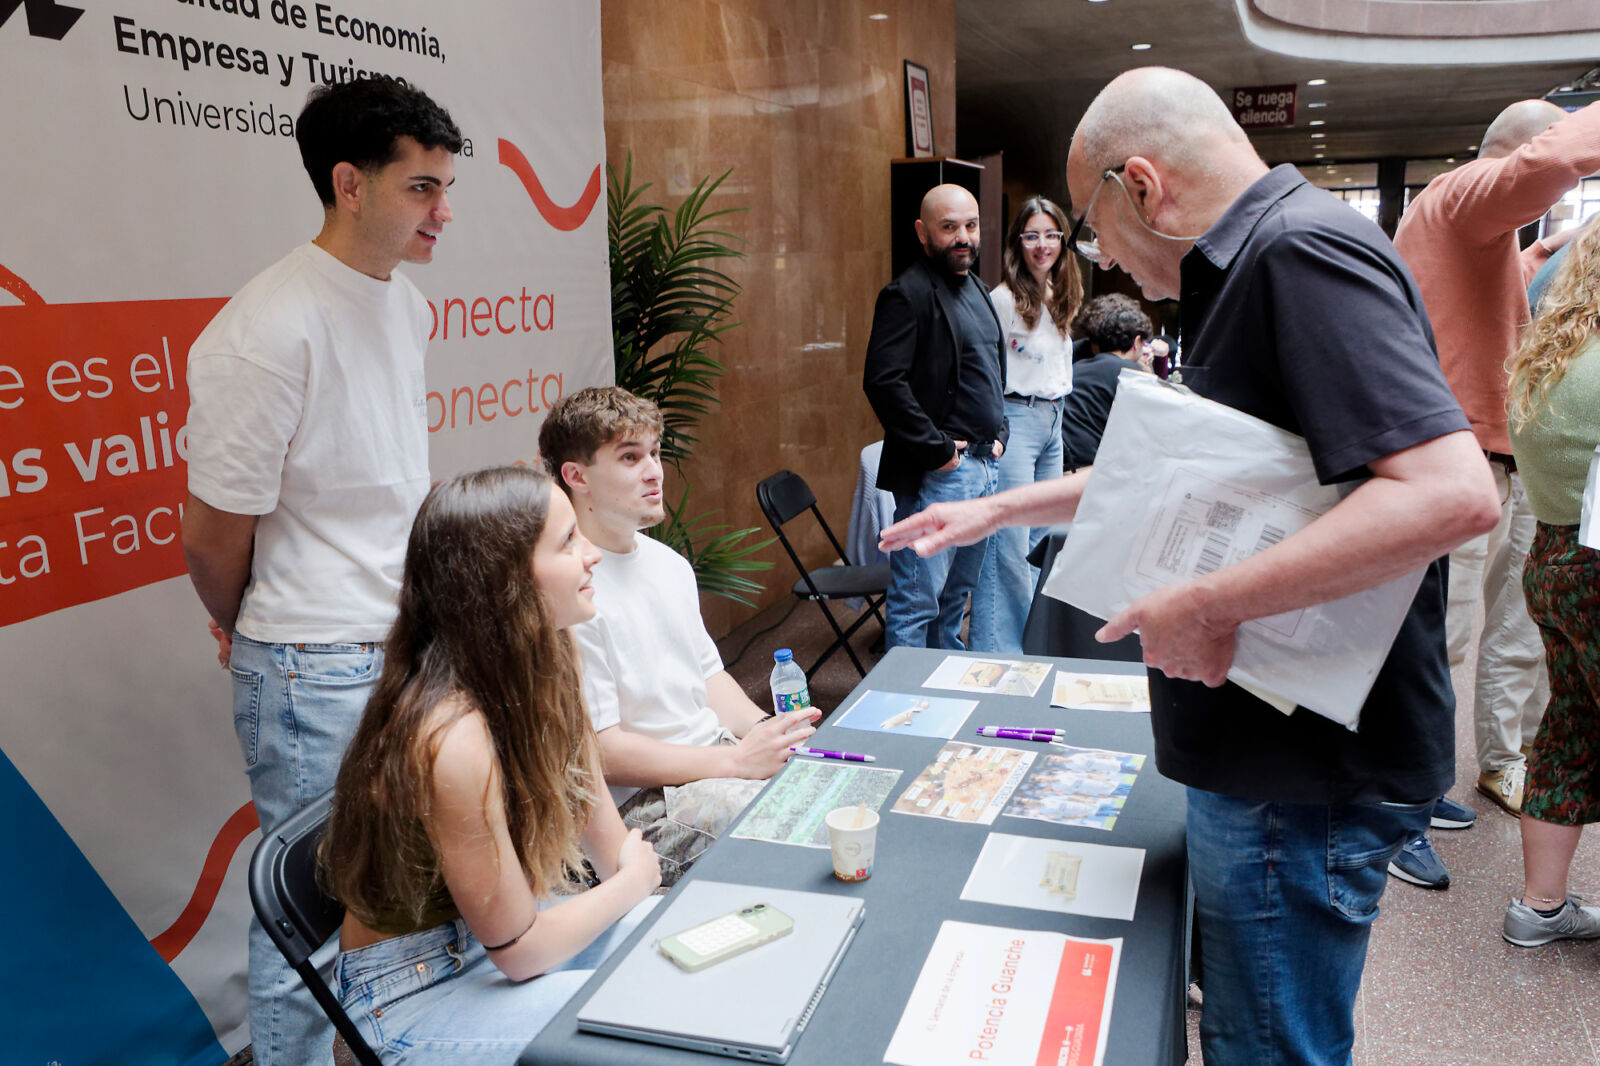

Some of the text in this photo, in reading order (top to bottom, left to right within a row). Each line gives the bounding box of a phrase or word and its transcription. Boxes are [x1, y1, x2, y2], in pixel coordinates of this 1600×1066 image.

[113, 15, 269, 76] Empresa
[277, 53, 295, 87] y
[177, 0, 446, 64] tad de Economía,
[123, 84, 295, 138] Universida
[1236, 91, 1293, 108] Se ruega
[1240, 108, 1288, 124] silencio
[46, 356, 114, 402] es
[130, 336, 175, 393] el
[73, 503, 184, 566] Fac
[969, 939, 1025, 1061] Potencia Guanche
